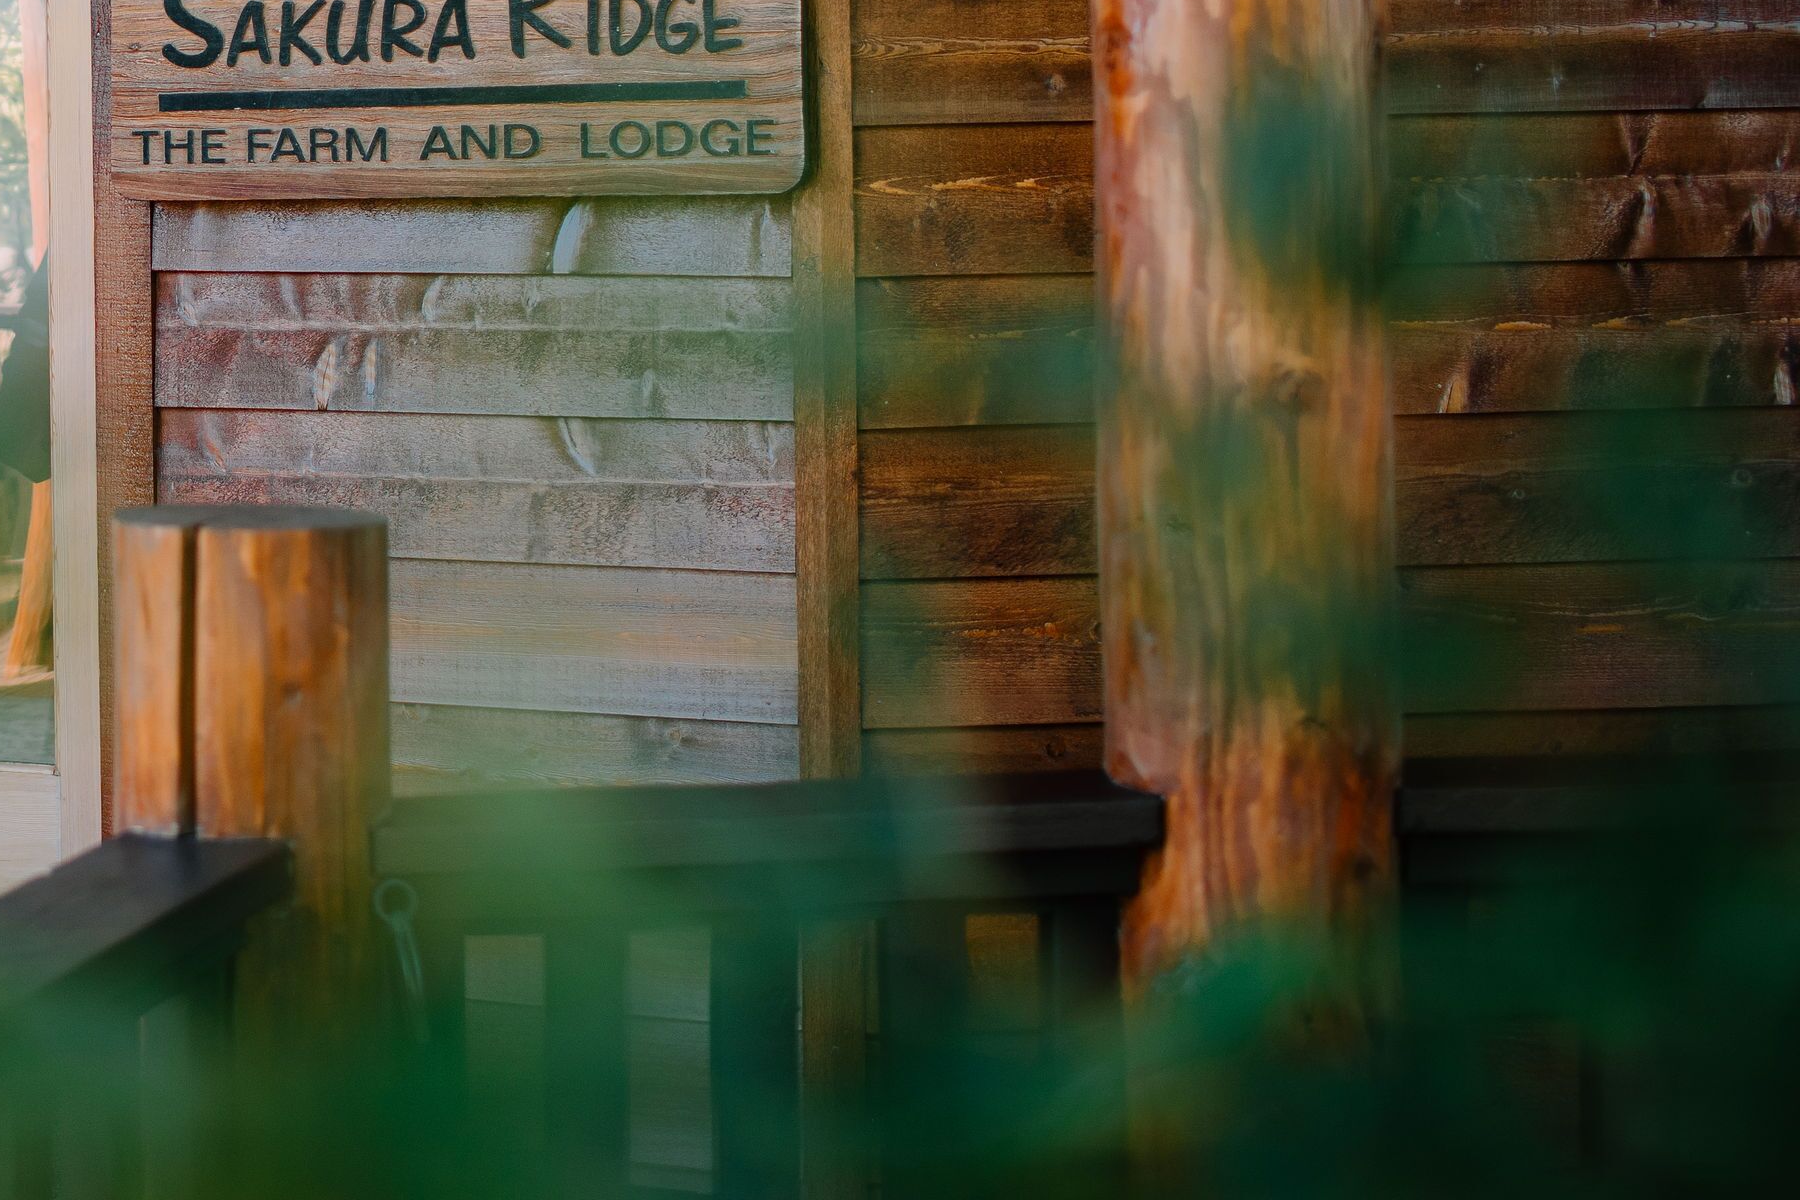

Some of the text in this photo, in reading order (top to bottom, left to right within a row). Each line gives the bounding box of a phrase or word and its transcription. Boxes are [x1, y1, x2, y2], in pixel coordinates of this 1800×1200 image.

[132, 118, 777, 165] THE FARM AND LODGE
